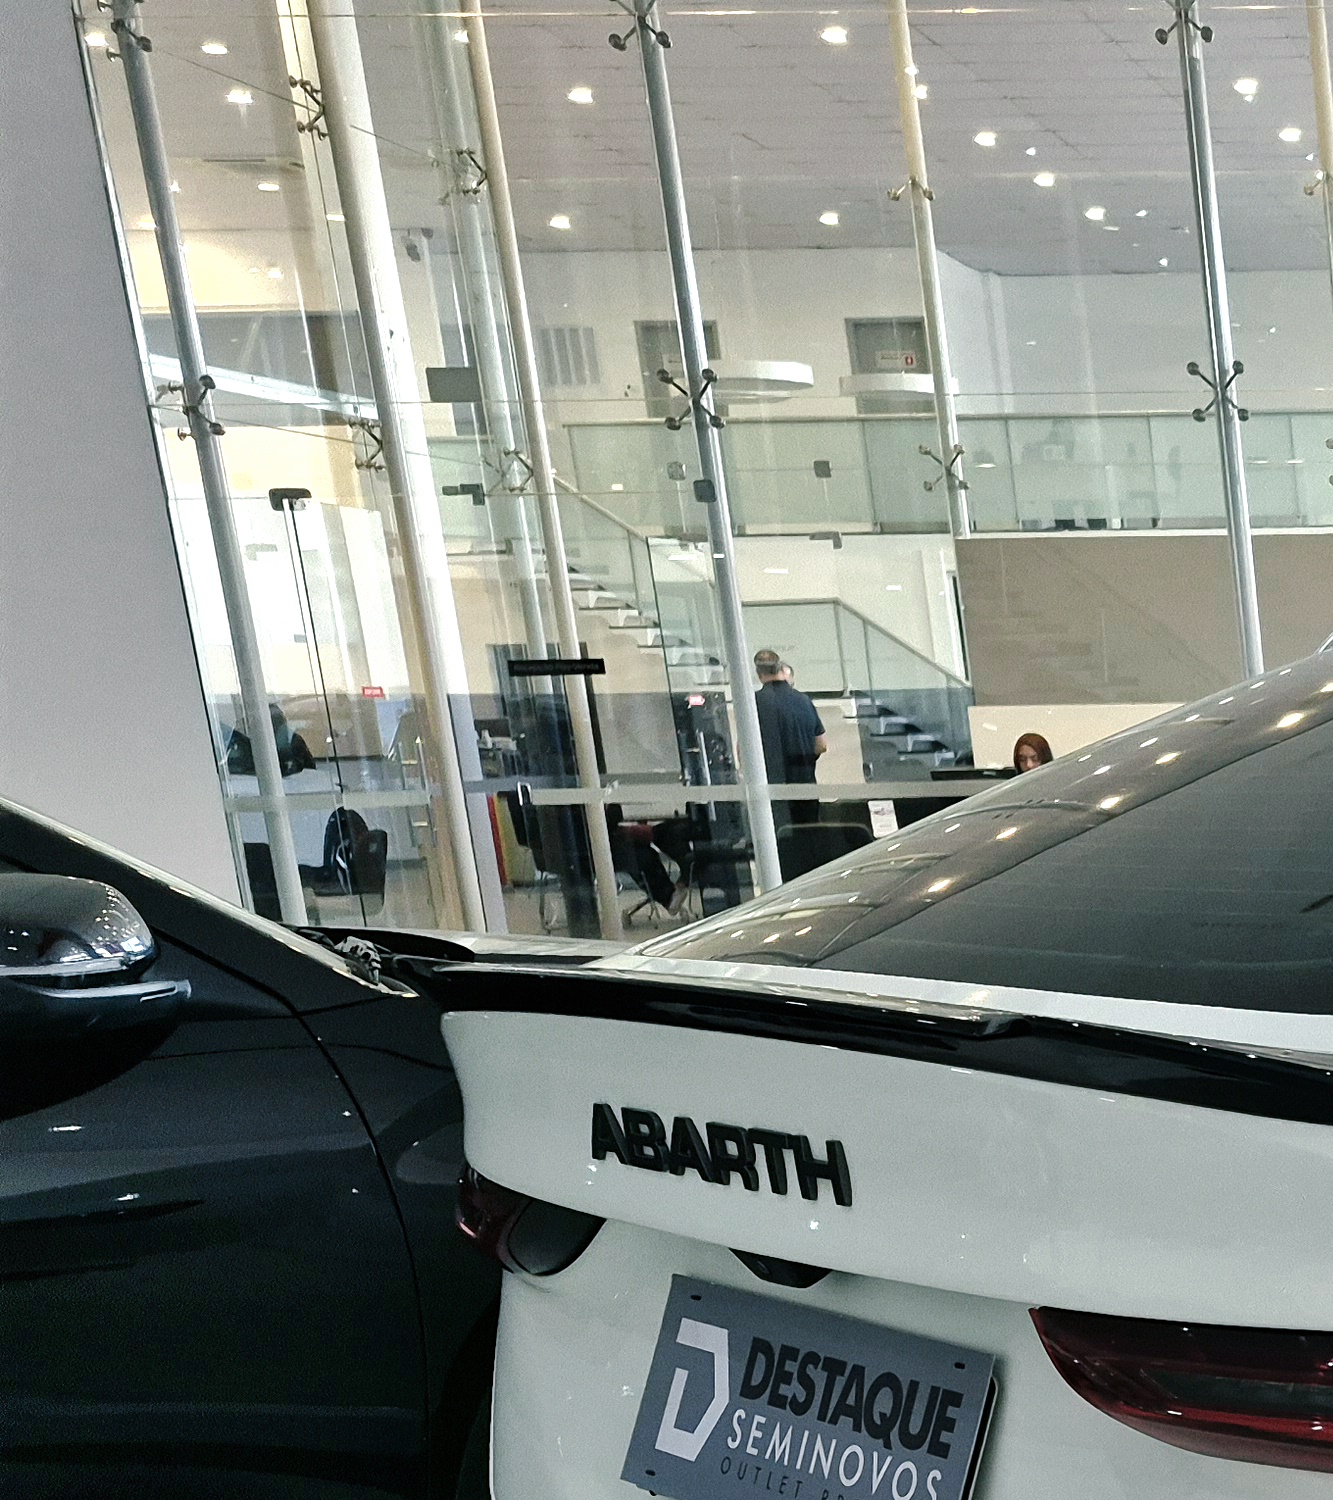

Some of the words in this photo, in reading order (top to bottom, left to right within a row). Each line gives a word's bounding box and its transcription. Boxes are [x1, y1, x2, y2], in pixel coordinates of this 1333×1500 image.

[591, 1103, 853, 1207] ABARTH
[739, 1336, 964, 1459] DESTAQUE
[720, 1456, 804, 1499] OUTLET
